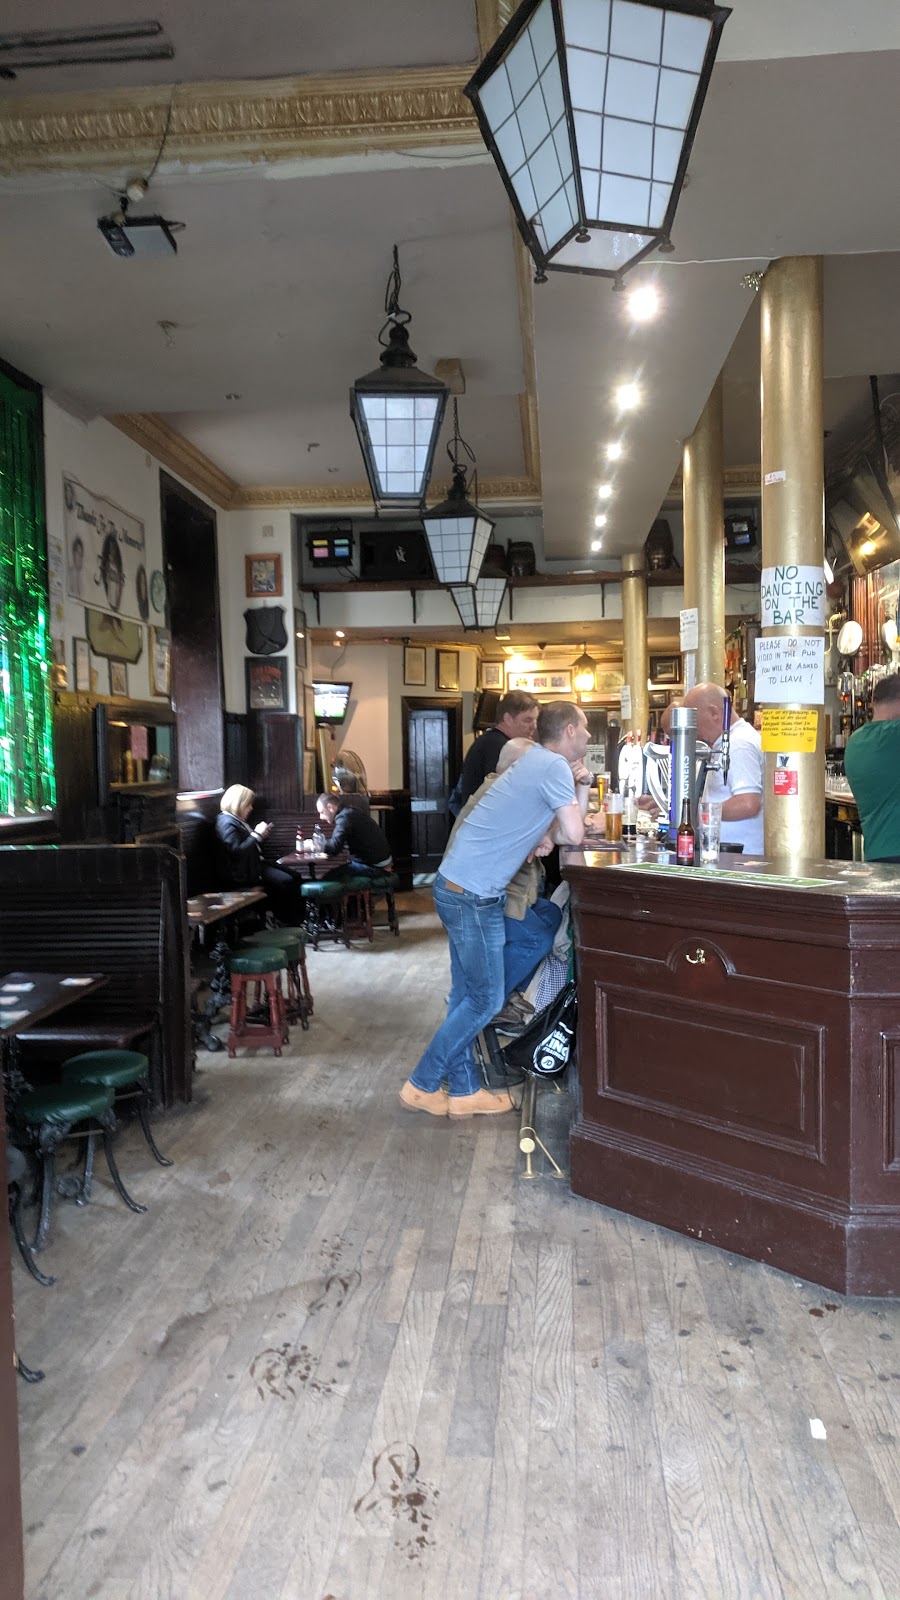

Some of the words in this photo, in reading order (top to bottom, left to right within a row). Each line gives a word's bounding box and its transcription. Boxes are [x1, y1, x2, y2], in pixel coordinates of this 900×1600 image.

[775, 566, 798, 581] NO
[762, 582, 823, 599] DANCING
[765, 598, 779, 610] ON
[788, 596, 819, 609] THE
[774, 609, 805, 625] BAR
[760, 640, 781, 651] PLEASE
[788, 639, 798, 647] DO
[757, 653, 773, 662] VIDEO
[782, 650, 796, 658] THE
[785, 663, 792, 671] BE
[767, 676, 777, 684] TO
[780, 675, 802, 683] LEAVE
